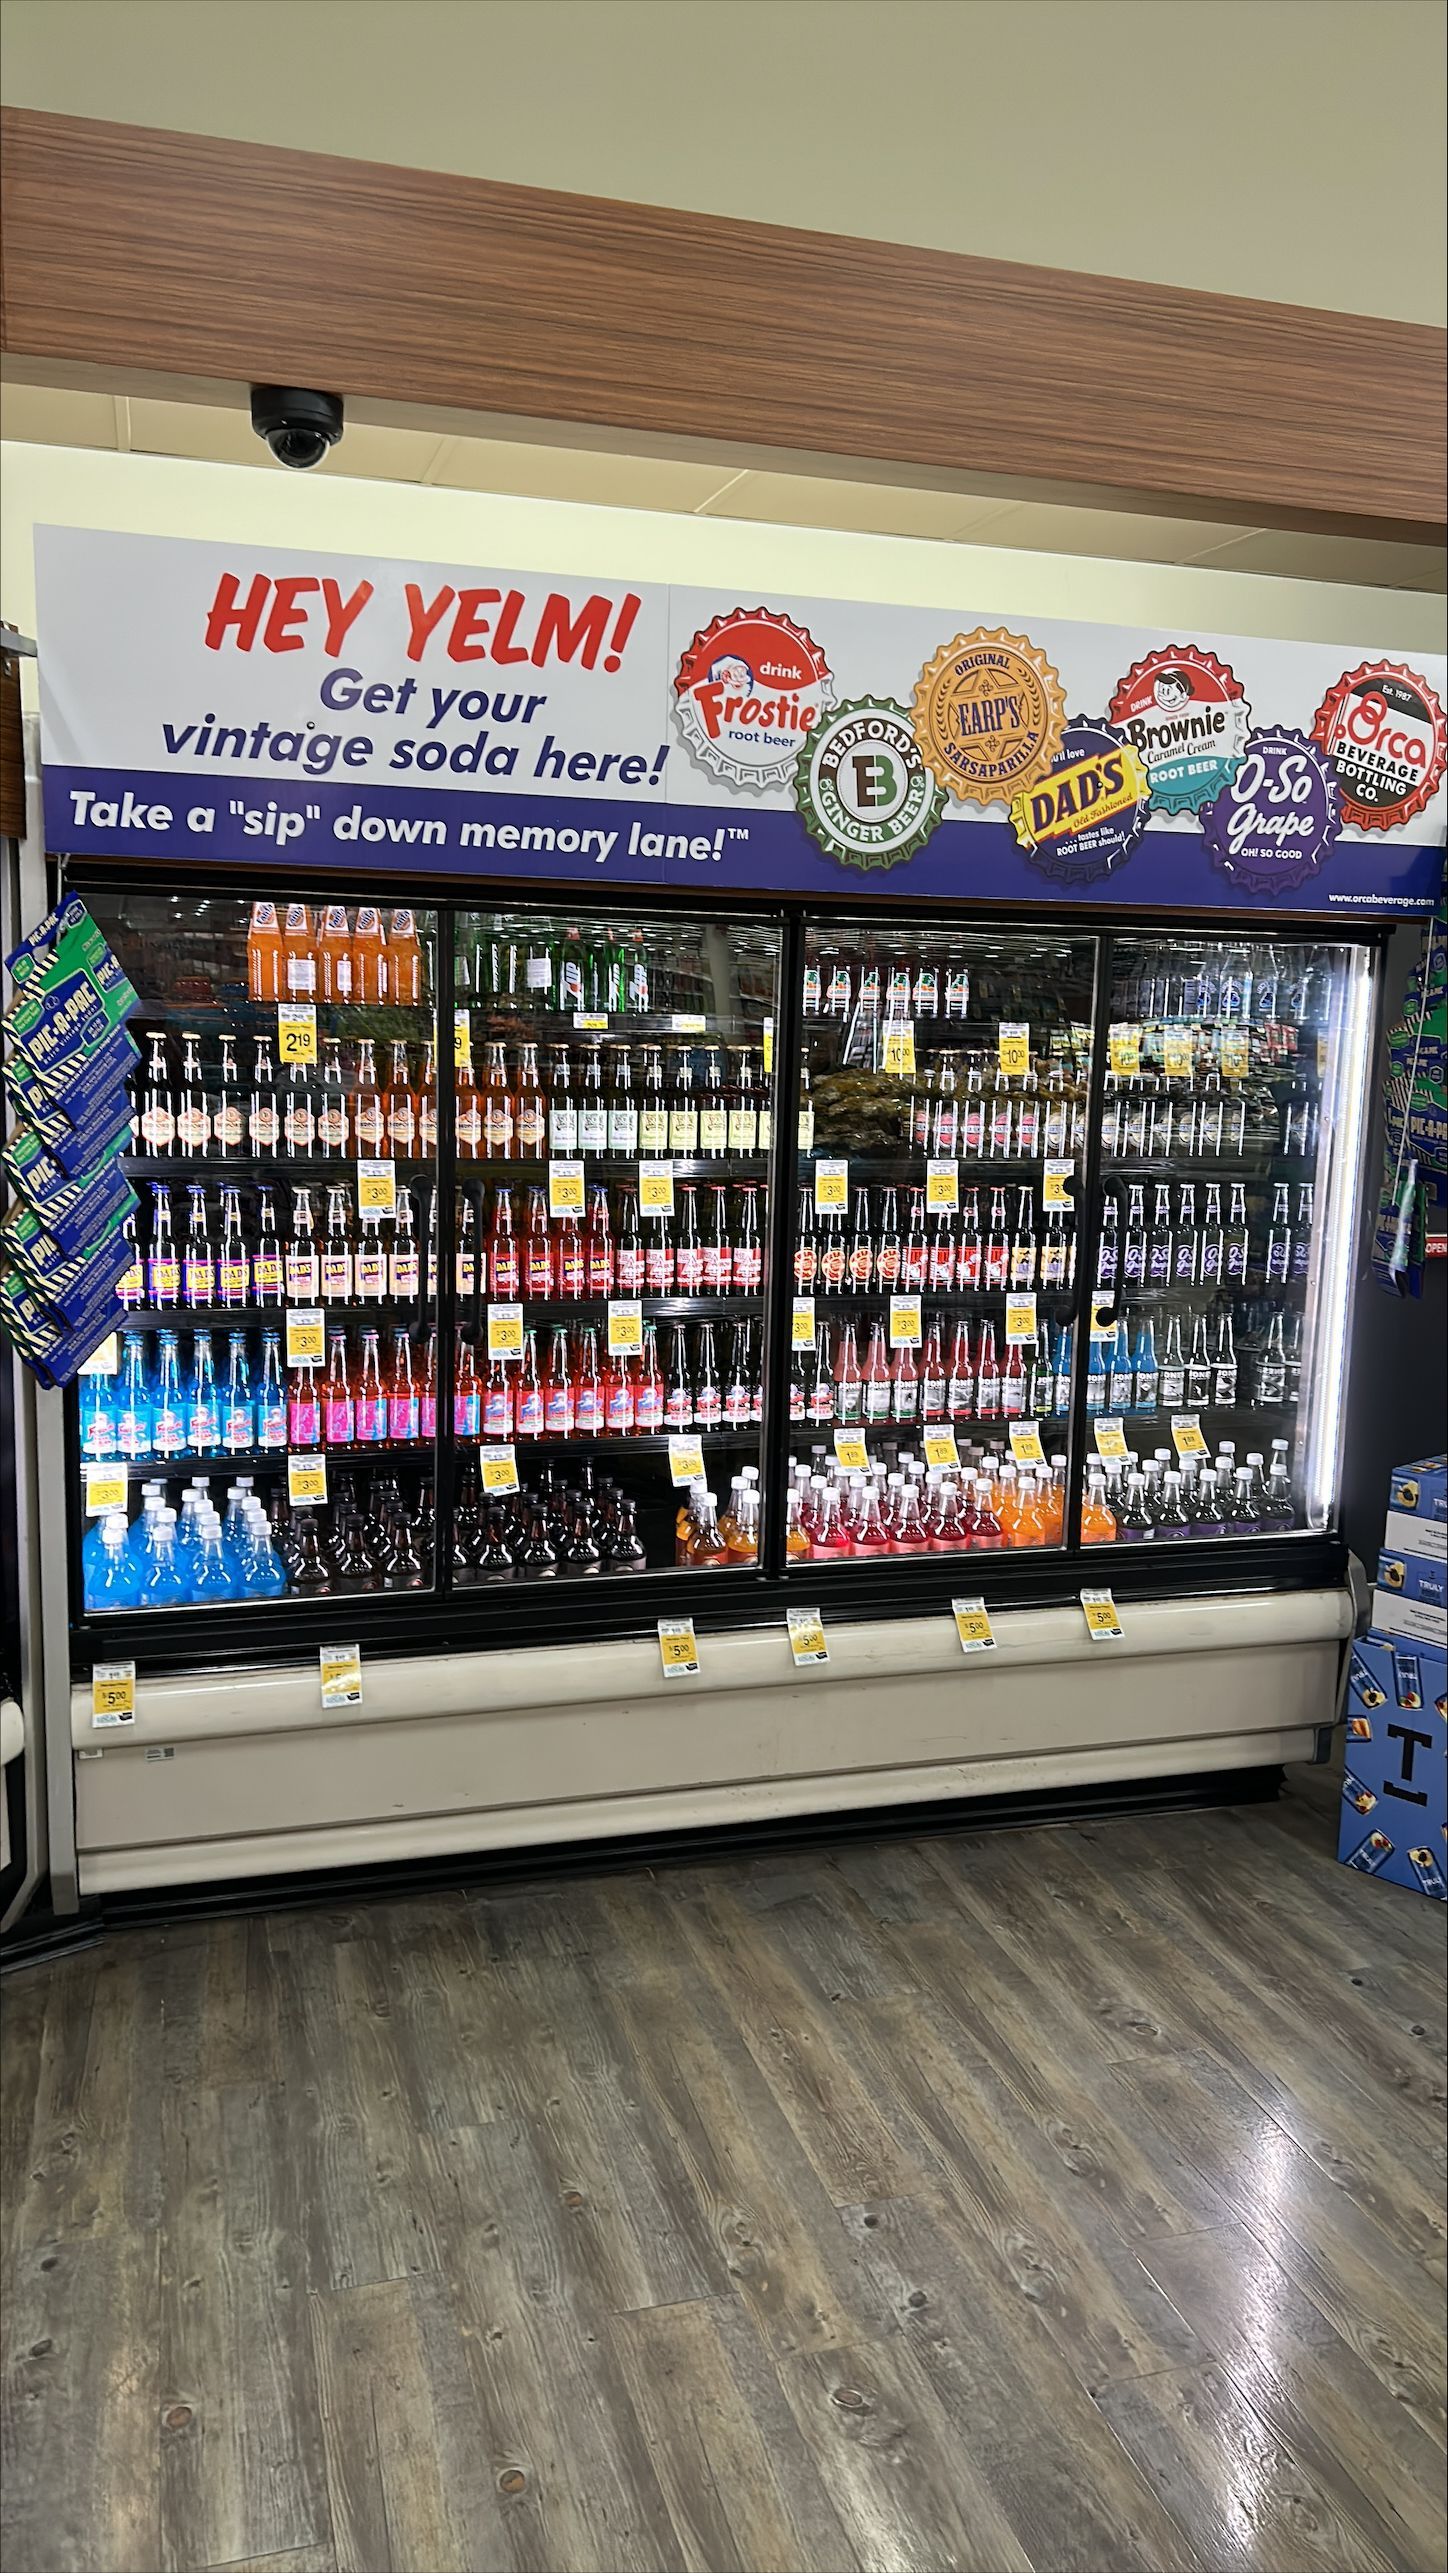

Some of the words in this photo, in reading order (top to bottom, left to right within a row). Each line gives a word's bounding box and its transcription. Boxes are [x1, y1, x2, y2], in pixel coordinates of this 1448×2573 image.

[205, 573, 374, 658] HEY
[404, 583, 641, 673] YELM!
[759, 661, 802, 682] drink
[954, 653, 1011, 677] ORIGINAL
[319, 667, 417, 715] Get
[426, 685, 548, 729] your
[1130, 696, 1153, 713] DRINK
[1382, 684, 1395, 696] Est.
[1396, 688, 1412, 701] 1987
[693, 679, 816, 740] Frostie
[958, 696, 1022, 738] EARP'S
[728, 728, 760, 744] root
[763, 732, 797, 748] beer
[1127, 706, 1226, 753] Brownie
[1335, 691, 1427, 770] Orca
[162, 714, 373, 775] vintage
[389, 731, 518, 776] soda
[534, 735, 670, 785] here!
[821, 717, 923, 769] BEDFORD'S
[943, 730, 1041, 777] SARSAPARILLA
[1067, 748, 1085, 759] love
[1147, 743, 1185, 764] Caramel
[1187, 740, 1216, 756] Cream
[1262, 746, 1287, 756] DRINK
[1150, 767, 1185, 784] ROOT
[1187, 760, 1219, 776] BEER
[1336, 741, 1419, 783] BEVERAGE
[1230, 753, 1313, 804] O-So
[1335, 761, 1408, 797] BOTTLING
[1030, 757, 1125, 833] DAD'S
[1355, 785, 1379, 803] CO.
[820, 788, 885, 844] GINGER
[887, 787, 924, 839] BEER
[1073, 814, 1089, 829] Old
[1091, 793, 1133, 820] Fashioned
[69, 790, 173, 832] Take
[187, 805, 215, 833] a
[230, 800, 321, 846] "sip"
[334, 806, 447, 847] down
[460, 823, 617, 863] memory
[1100, 827, 1115, 838] like
[1056, 843, 1077, 857] ROOT
[1079, 839, 1098, 852] BEER
[1098, 831, 1126, 846] should!
[1241, 848, 1260, 858] OH!
[1260, 848, 1273, 859] SO
[1274, 849, 1303, 860] GOOD
[1328, 893, 1435, 907] www.orcabeverage.com
[1410, 1115, 1447, 1137] PIC-A-PA
[1425, 1243, 1447, 1254] OPEN
[1418, 1579, 1444, 1593] TRULY
